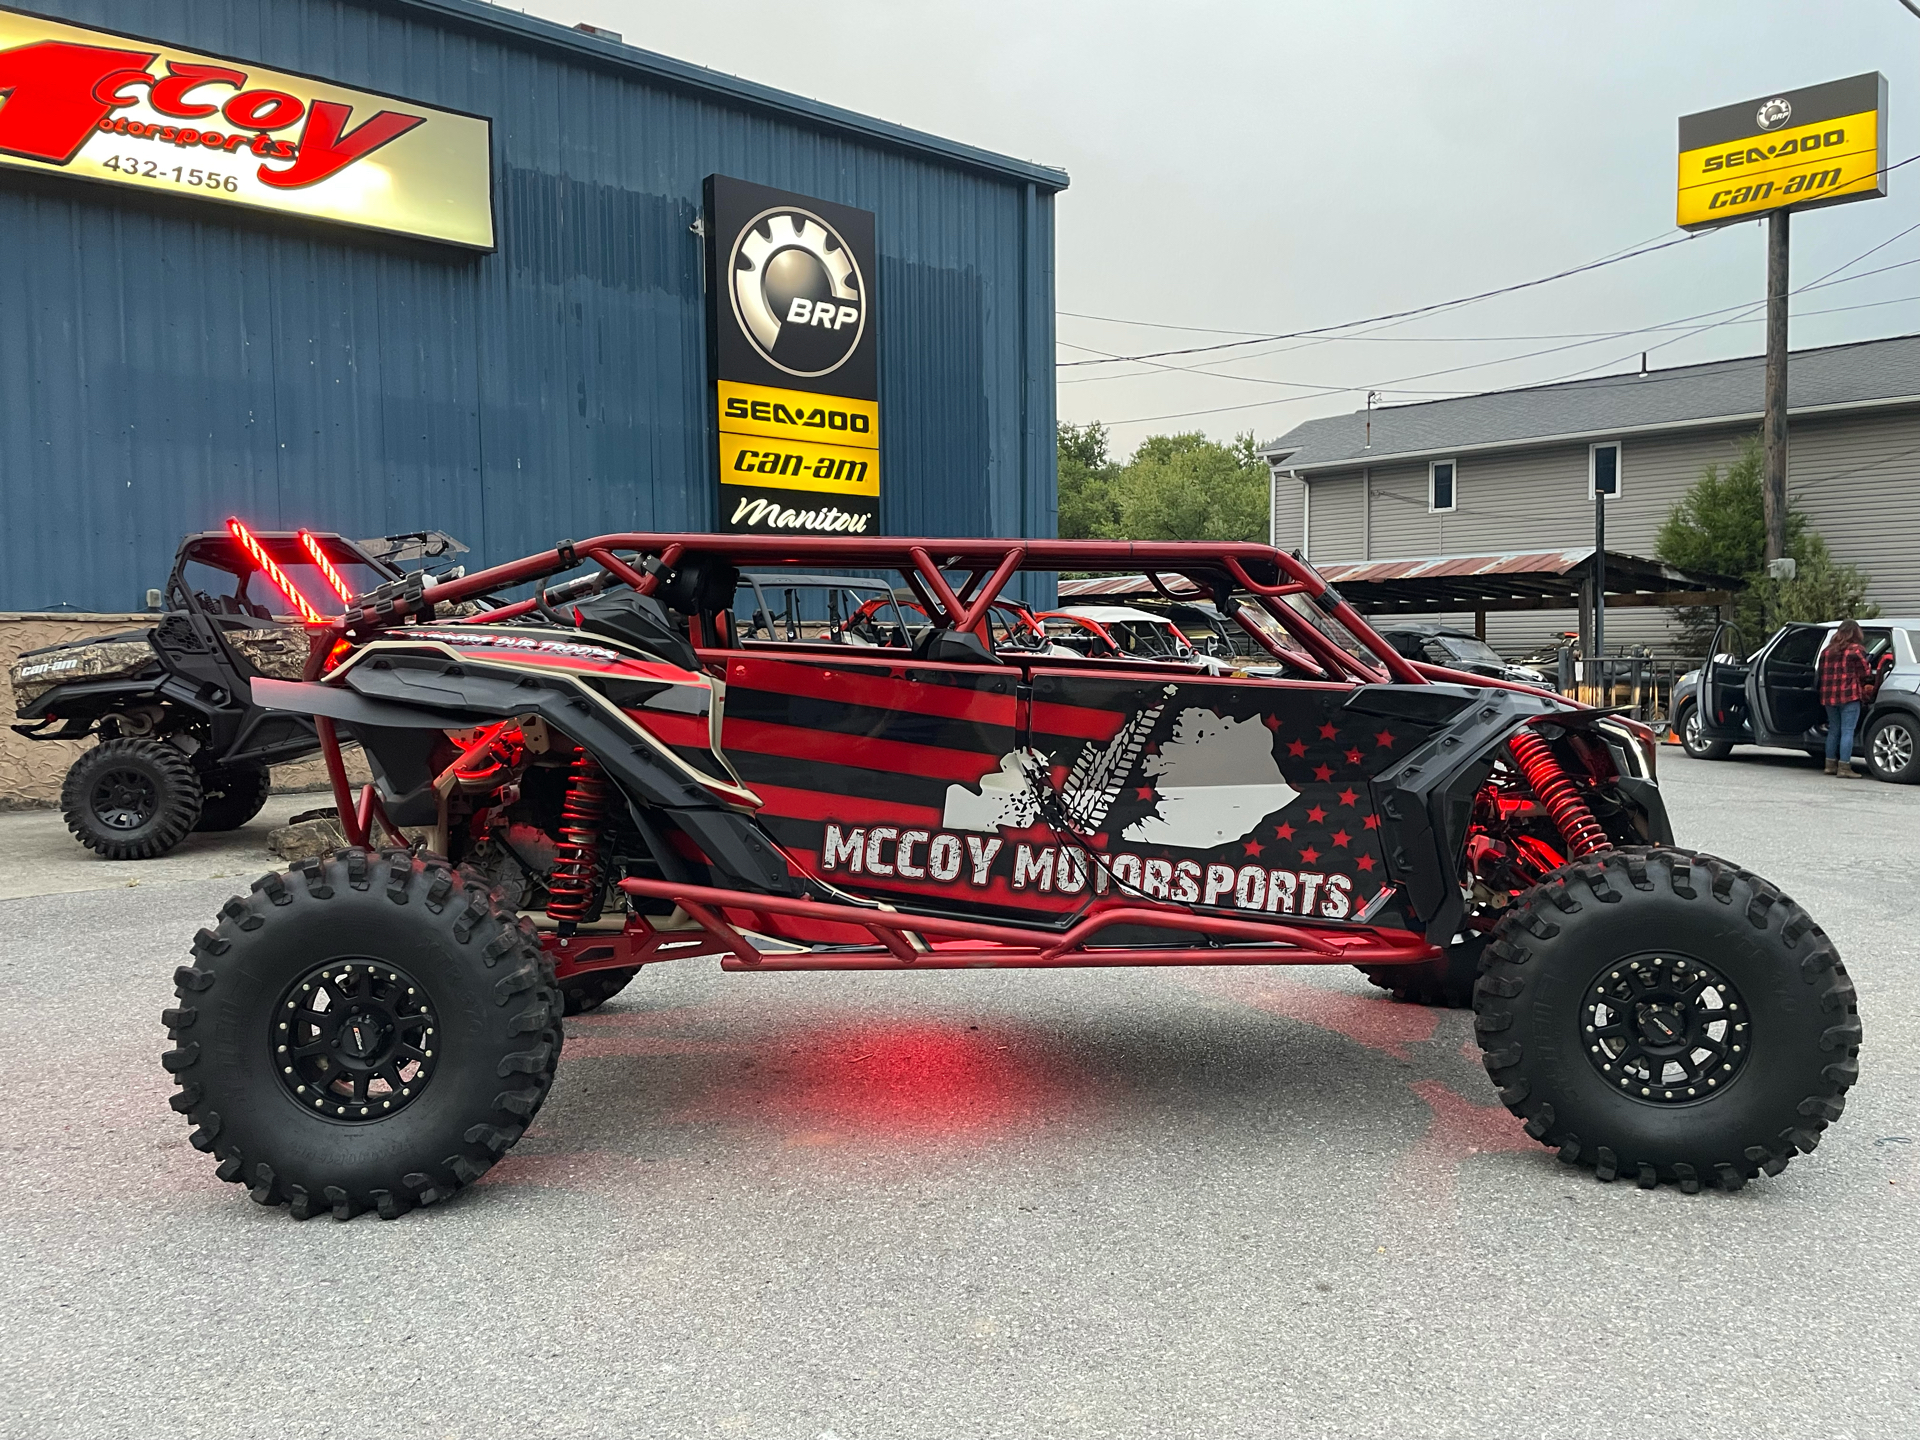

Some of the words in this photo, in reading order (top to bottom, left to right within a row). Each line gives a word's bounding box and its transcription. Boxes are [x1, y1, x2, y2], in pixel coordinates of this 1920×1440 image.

[103, 154, 239, 193] 432-1556
[1708, 168, 1843, 210] can-am
[786, 296, 859, 330] BRP
[733, 449, 869, 482] can-am
[730, 496, 869, 533] Manitou
[21, 659, 78, 677] can-am
[539, 641, 619, 660] TROOPS
[823, 824, 1003, 885] MCCOY
[1013, 844, 1353, 920] MOTORSPORTS
